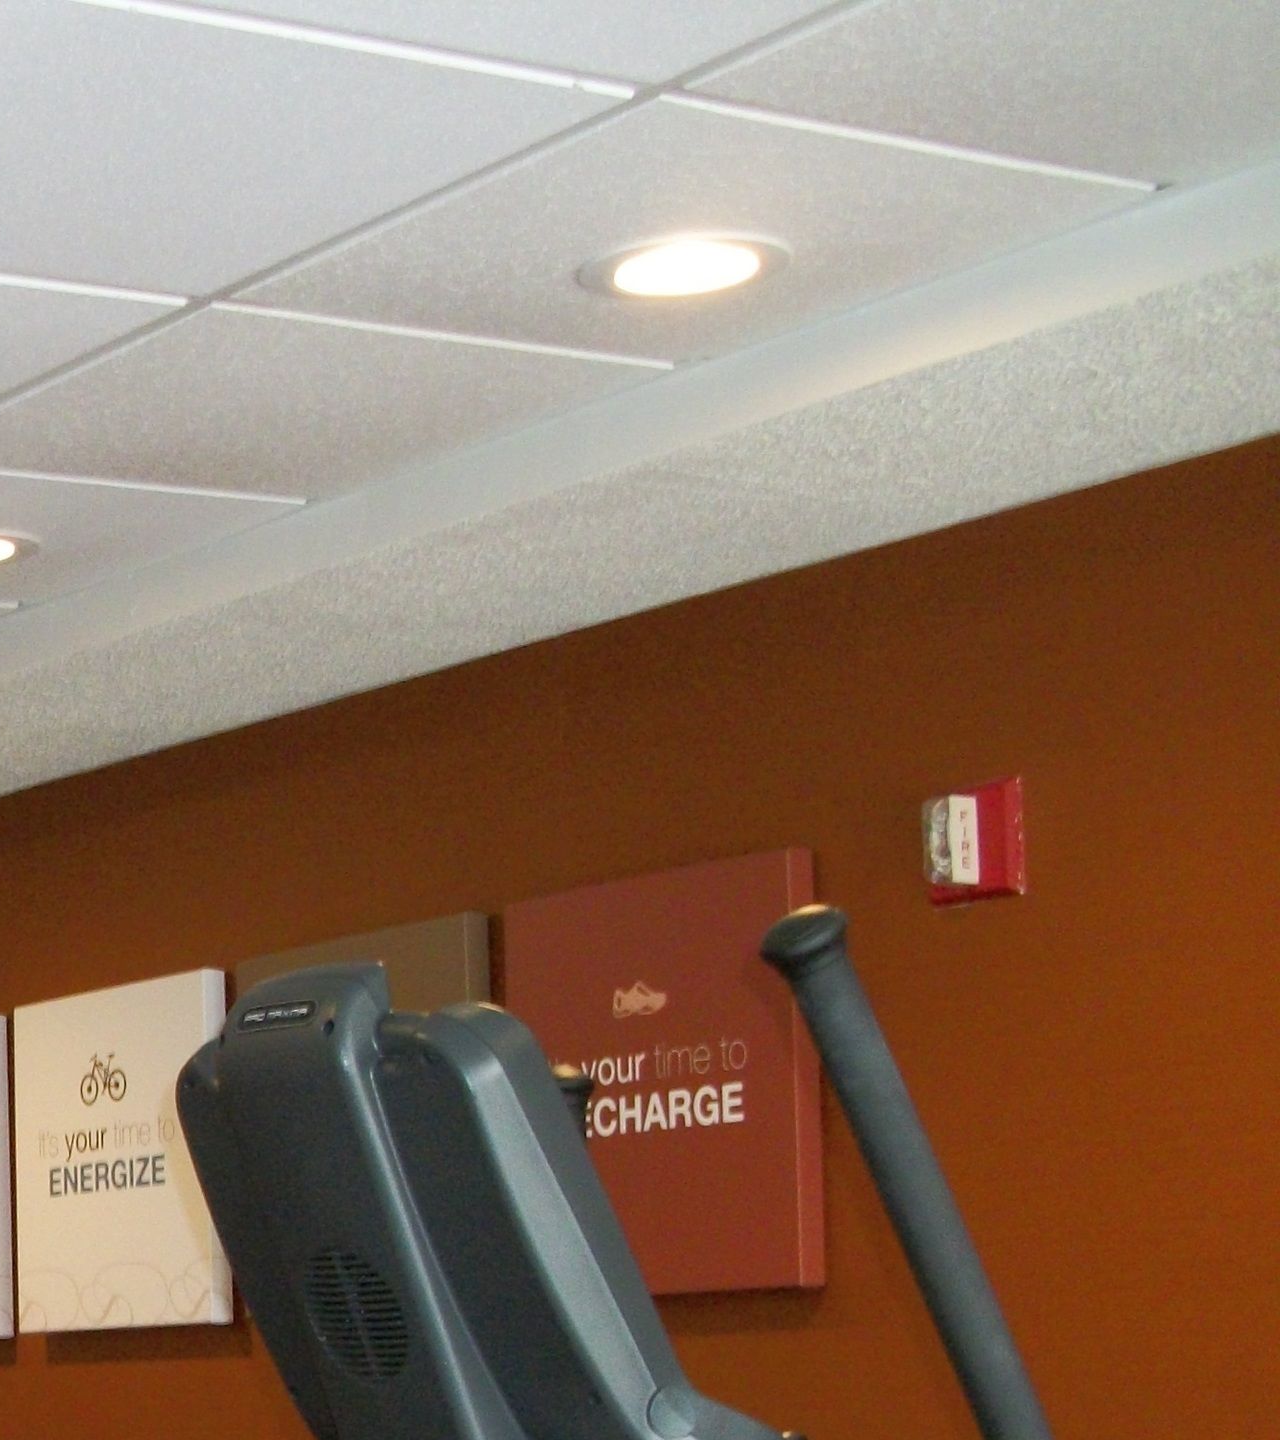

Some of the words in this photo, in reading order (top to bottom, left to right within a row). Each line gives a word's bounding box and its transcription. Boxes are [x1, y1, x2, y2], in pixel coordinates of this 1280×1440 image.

[581, 1053, 645, 1086] your
[654, 1043, 711, 1079] time
[720, 1036, 748, 1072] to
[586, 1081, 745, 1138] CHARGE
[65, 1127, 107, 1162] your
[114, 1120, 151, 1147] time
[157, 1115, 175, 1143] to
[49, 1154, 166, 1197] ENERGIZE
